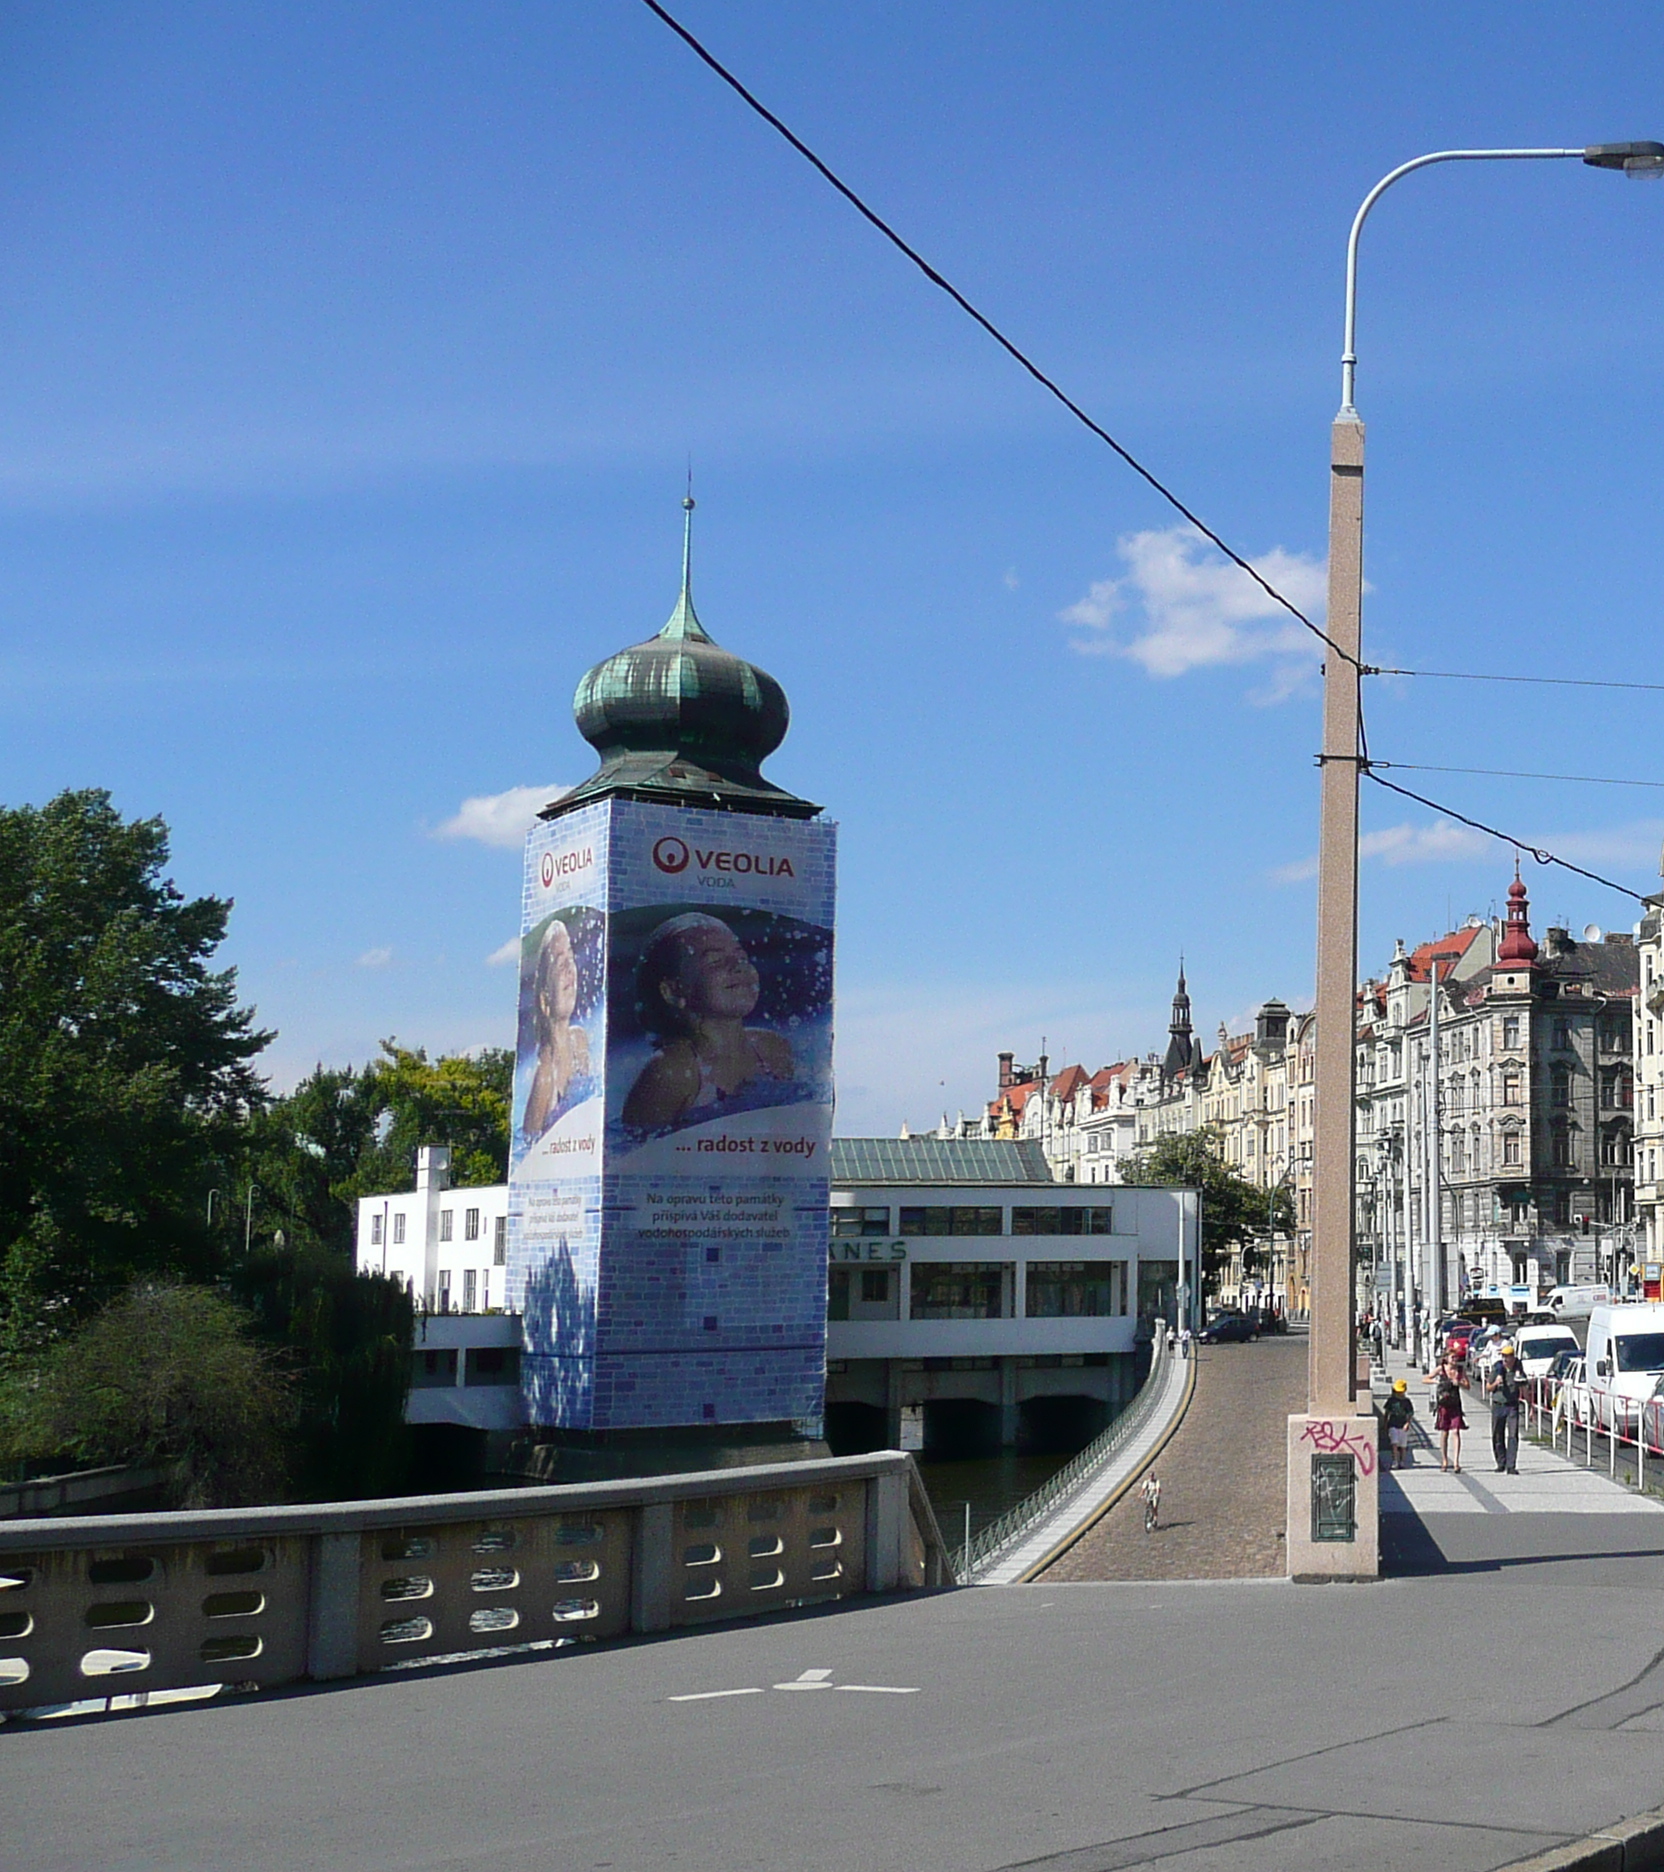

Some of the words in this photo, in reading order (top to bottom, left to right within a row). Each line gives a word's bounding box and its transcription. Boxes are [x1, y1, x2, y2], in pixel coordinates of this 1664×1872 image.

[555, 847, 592, 877] VEOLIA
[695, 849, 795, 877] VEOLIA
[697, 875, 736, 889] VODA
[550, 1136, 571, 1155] radost
[578, 1133, 596, 1156] vody
[697, 1134, 755, 1154] radost
[760, 1138, 772, 1154] z
[774, 1135, 817, 1158] vody
[646, 1192, 664, 1205] Na
[666, 1194, 707, 1207] opravu
[735, 1192, 785, 1208] památky
[700, 1209, 721, 1222] Váš
[723, 1209, 778, 1222] dodavatel
[638, 1226, 753, 1240] vodohospodářských
[755, 1226, 790, 1239] služeb
